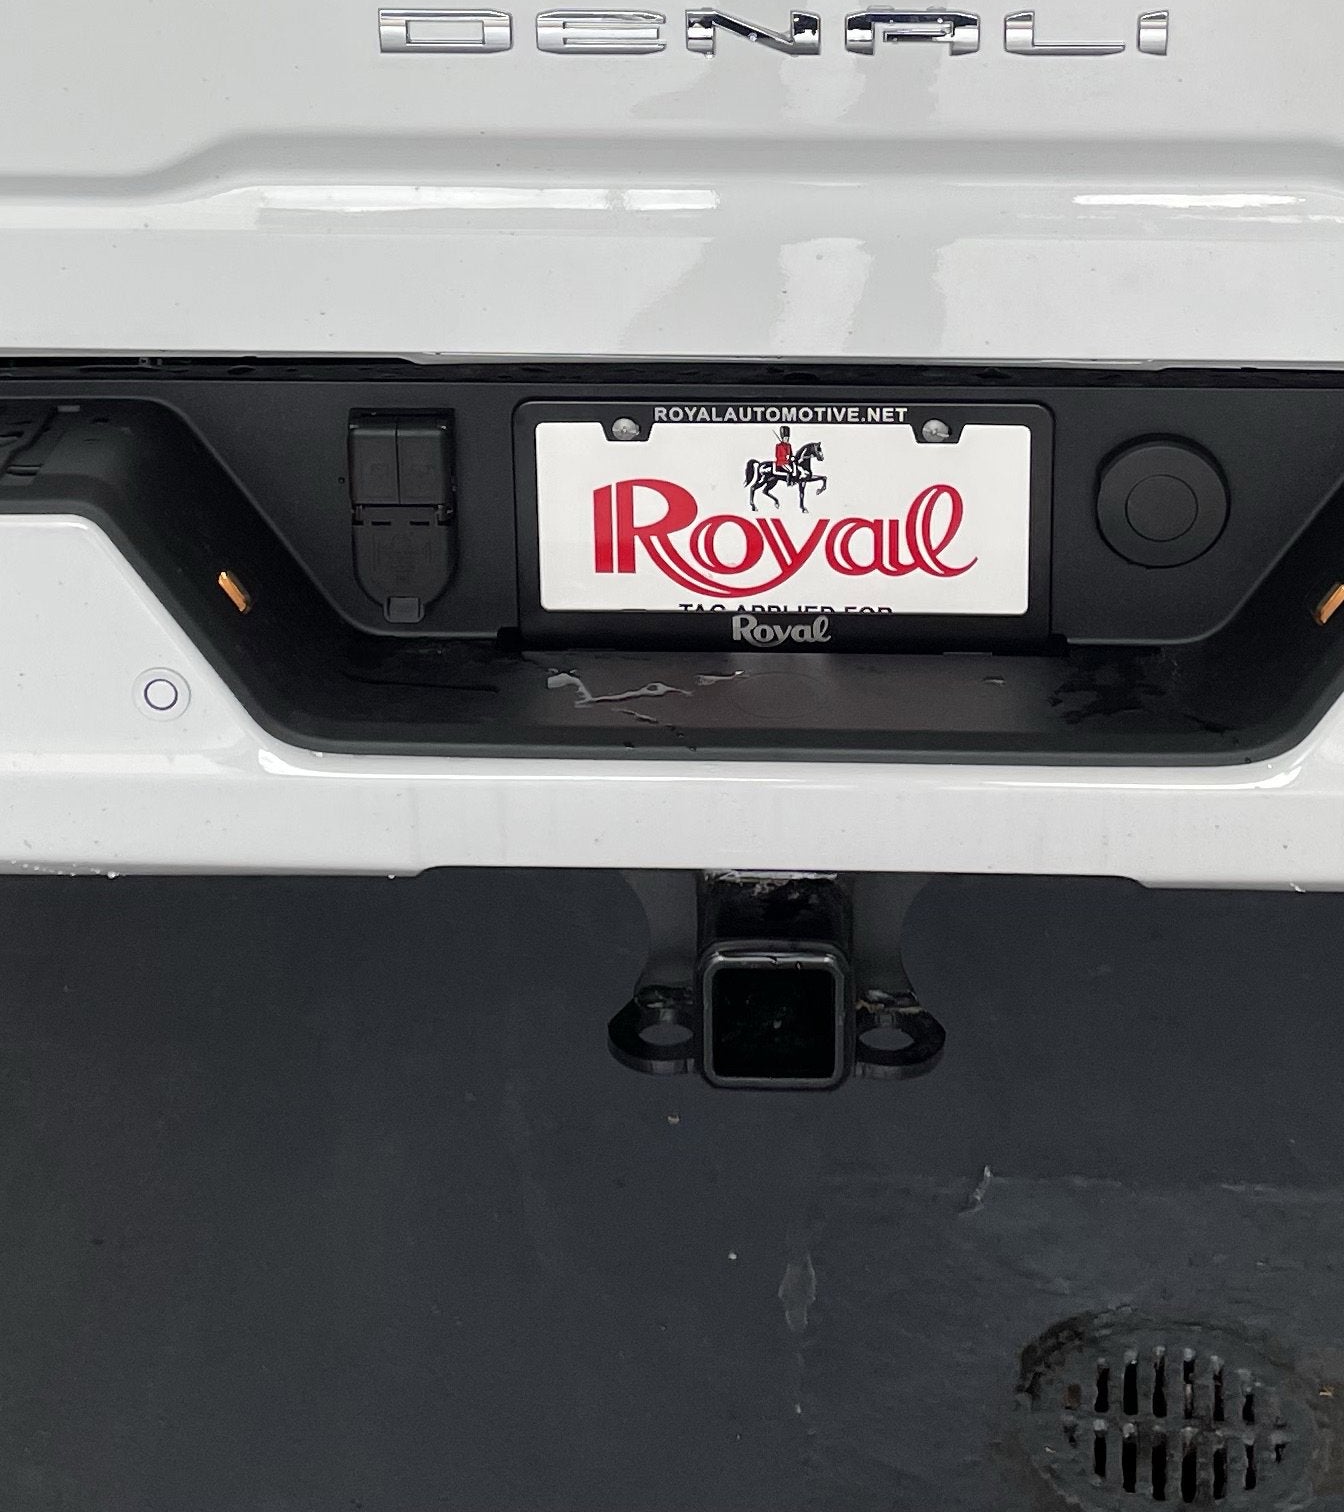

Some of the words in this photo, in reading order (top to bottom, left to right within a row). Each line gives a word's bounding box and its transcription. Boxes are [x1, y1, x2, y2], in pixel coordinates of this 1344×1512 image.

[378, 6, 1170, 56] DENALI
[654, 406, 909, 423] ROYALAUTOMOTIVE.NET
[593, 478, 979, 599] Royal
[731, 613, 832, 648] Royal
